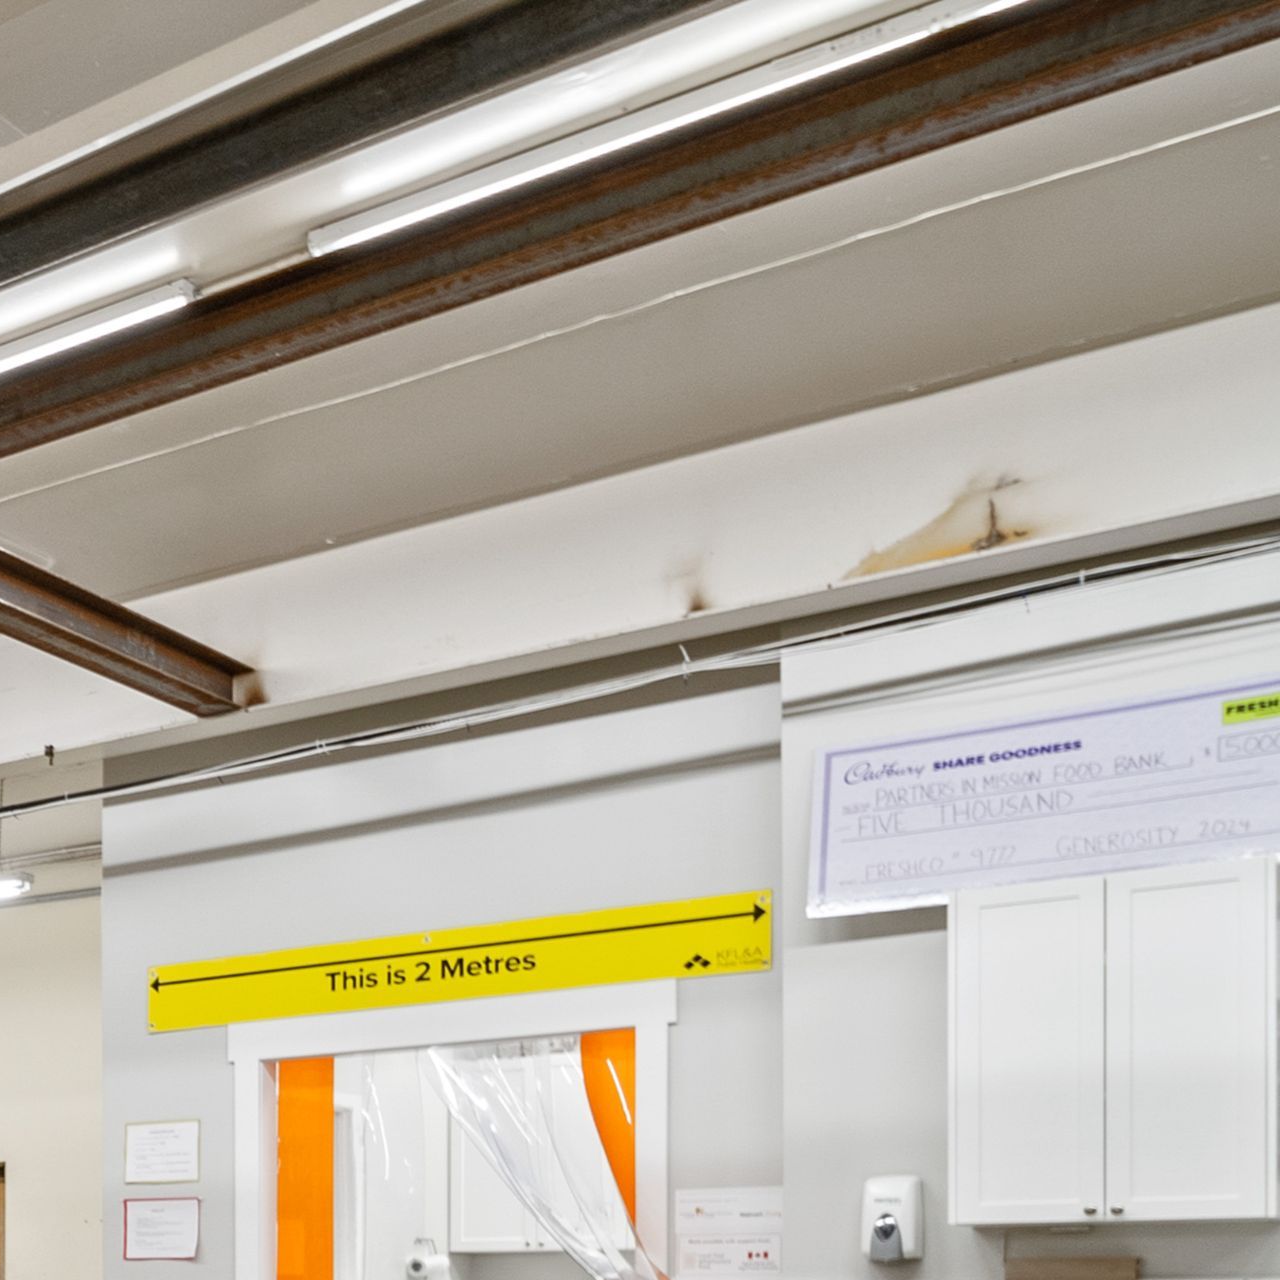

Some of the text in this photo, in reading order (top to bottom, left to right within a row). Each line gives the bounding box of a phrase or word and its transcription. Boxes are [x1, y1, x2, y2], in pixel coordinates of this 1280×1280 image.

[844, 740, 1082, 785] Cadbury SHARE GOODNESS
[874, 751, 1169, 807] PARTNERS IN MISSION FOOD BANK
[858, 790, 1074, 836] FIVE THOUSAND
[1056, 826, 1179, 858] GENEROSITY
[1199, 819, 1251, 838] 2024
[325, 954, 536, 992] This is 2 Metres
